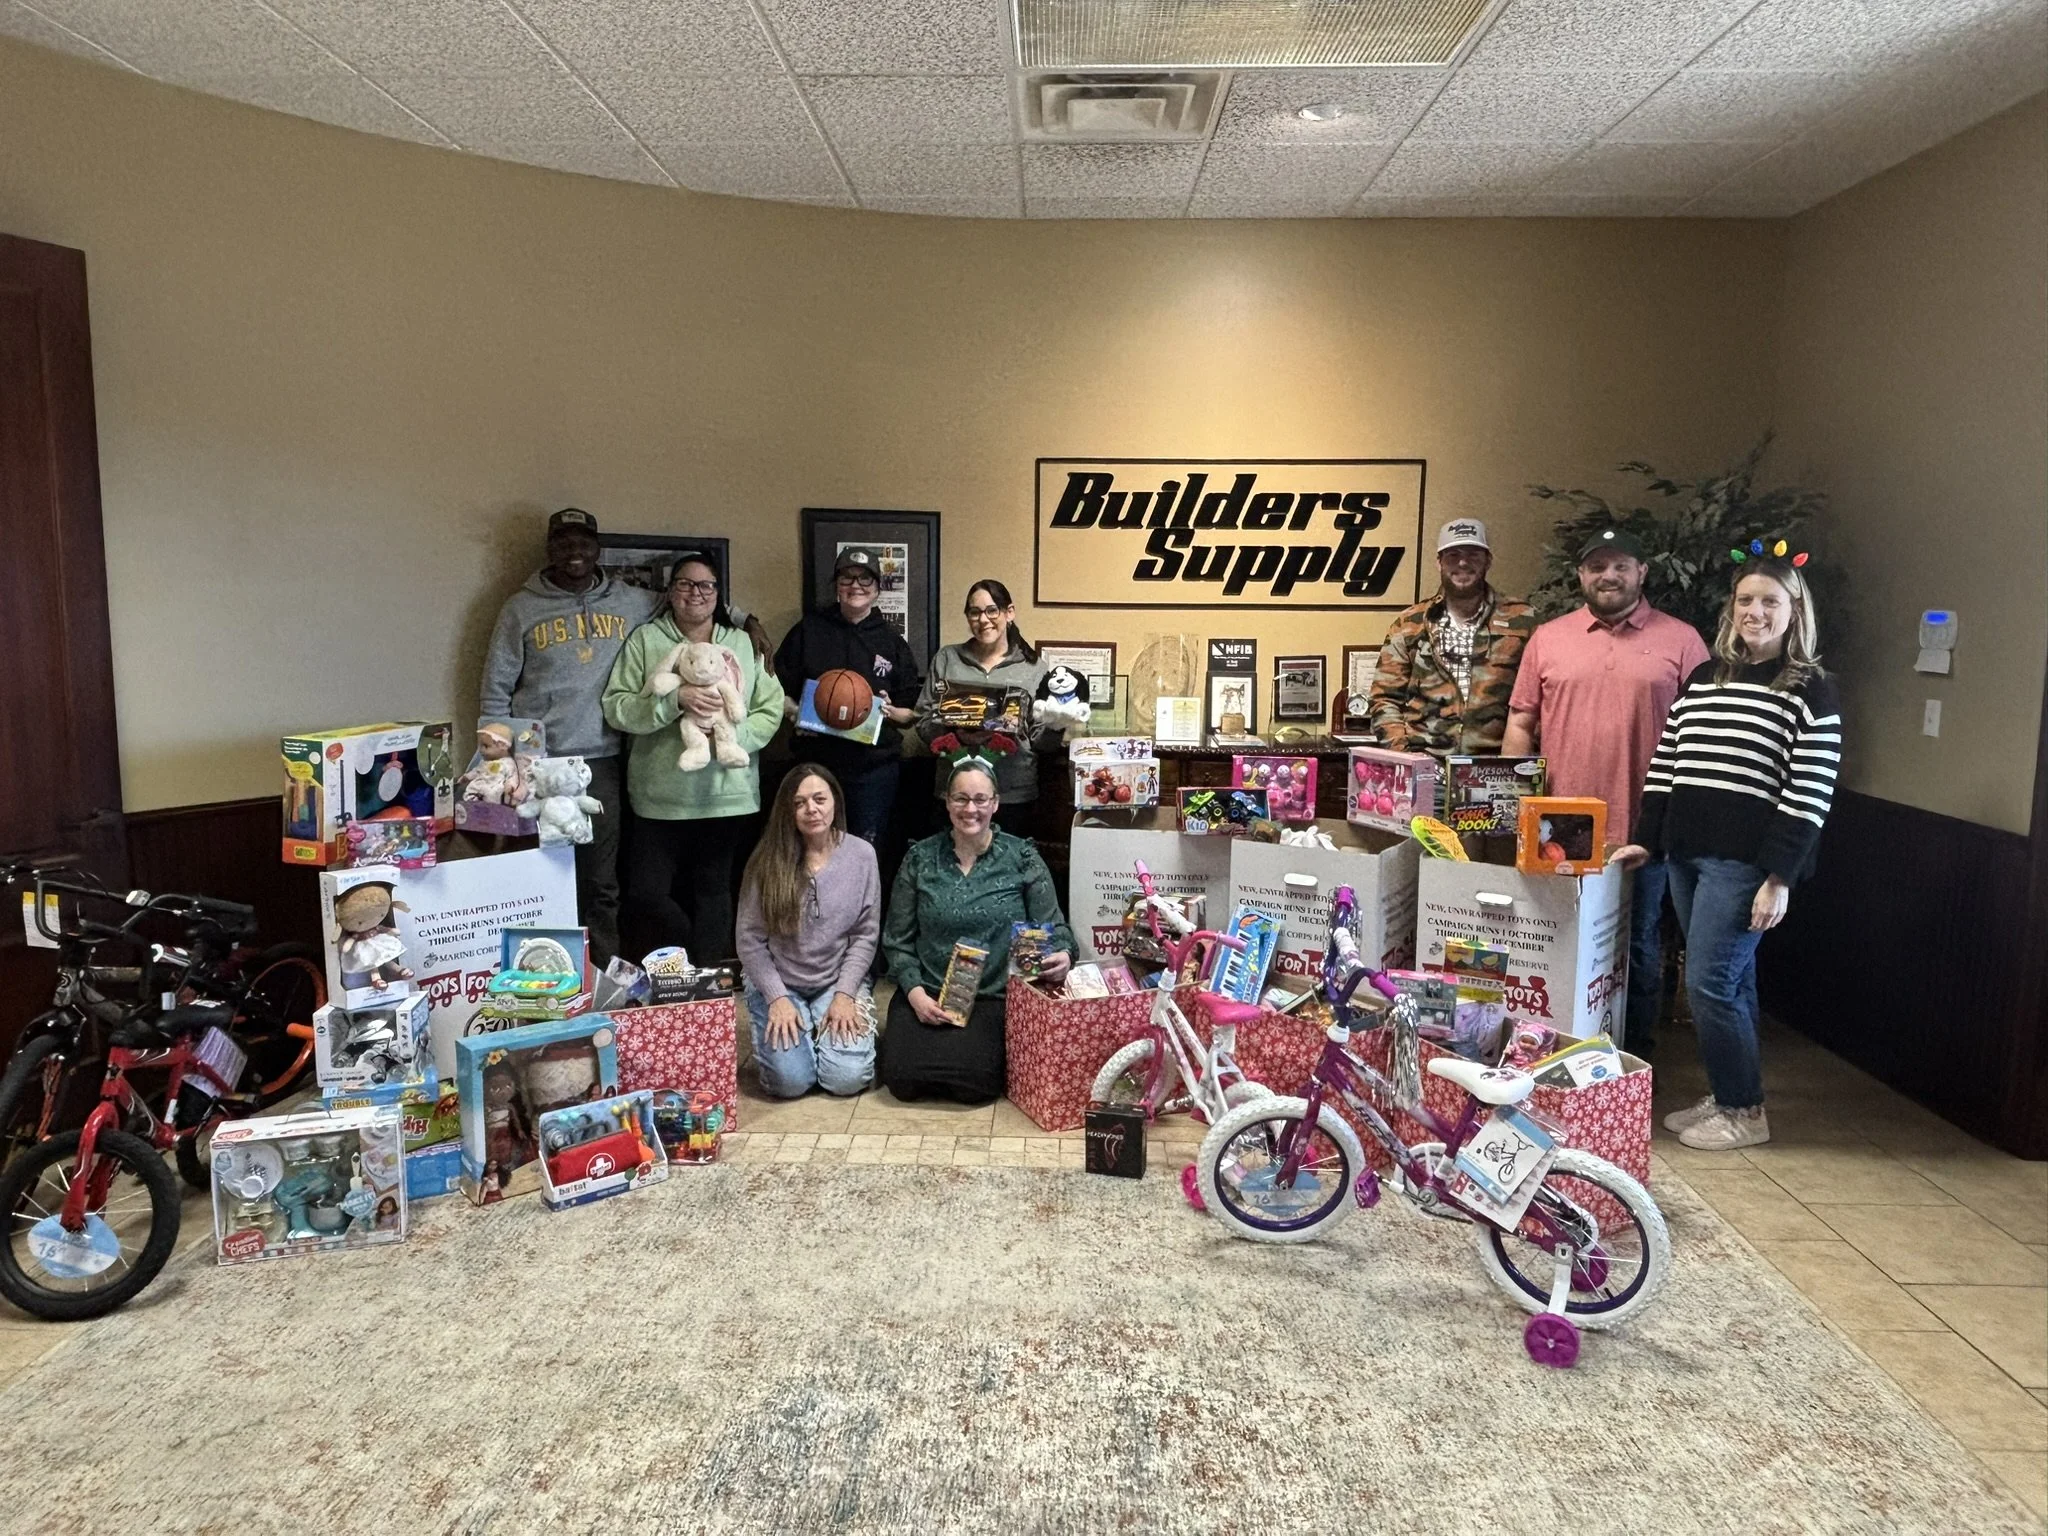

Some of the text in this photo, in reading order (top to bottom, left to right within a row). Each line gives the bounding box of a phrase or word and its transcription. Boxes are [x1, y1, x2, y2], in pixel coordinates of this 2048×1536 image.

[1050, 472, 1390, 530] Builders
[1132, 527, 1405, 597] Supply
[533, 612, 626, 650] U.S. NAVY
[1225, 644, 1253, 655] NFIB
[1450, 807, 1492, 822] COMIC
[1114, 871, 1165, 881] UNWRED
[1166, 886, 1207, 894] OCTOBER
[1259, 887, 1311, 901] UNWRAPPED
[414, 895, 546, 925] NEW, UNWRAPPED TOYS ONLY
[1239, 898, 1283, 911] CAMPAIGN
[1284, 902, 1306, 914] RUNS
[418, 922, 469, 938] CAMPAIGN
[470, 918, 495, 930] RUNS
[502, 909, 543, 924] OCTOBER
[1299, 915, 1330, 927] DECEM
[1425, 902, 1558, 929] NEW, UNWRAPPED TOYS ONLY
[1095, 929, 1126, 945] TOYS
[1287, 930, 1314, 941] CORPS
[1427, 917, 1474, 932] CAMPAIGN
[1475, 925, 1500, 936] RUNS
[1508, 930, 1554, 944] OCTOBER
[428, 931, 475, 947] THROUGH
[1435, 928, 1545, 953] THROUGH DECEMBER
[439, 944, 501, 963] MARINE CORP
[1277, 953, 1304, 973] FOR
[1508, 957, 1550, 971] RESERVE
[1504, 986, 1543, 1008] TOTS
[331, 1098, 371, 1111] TROUBLE
[230, 1241, 260, 1257] CHEFS
